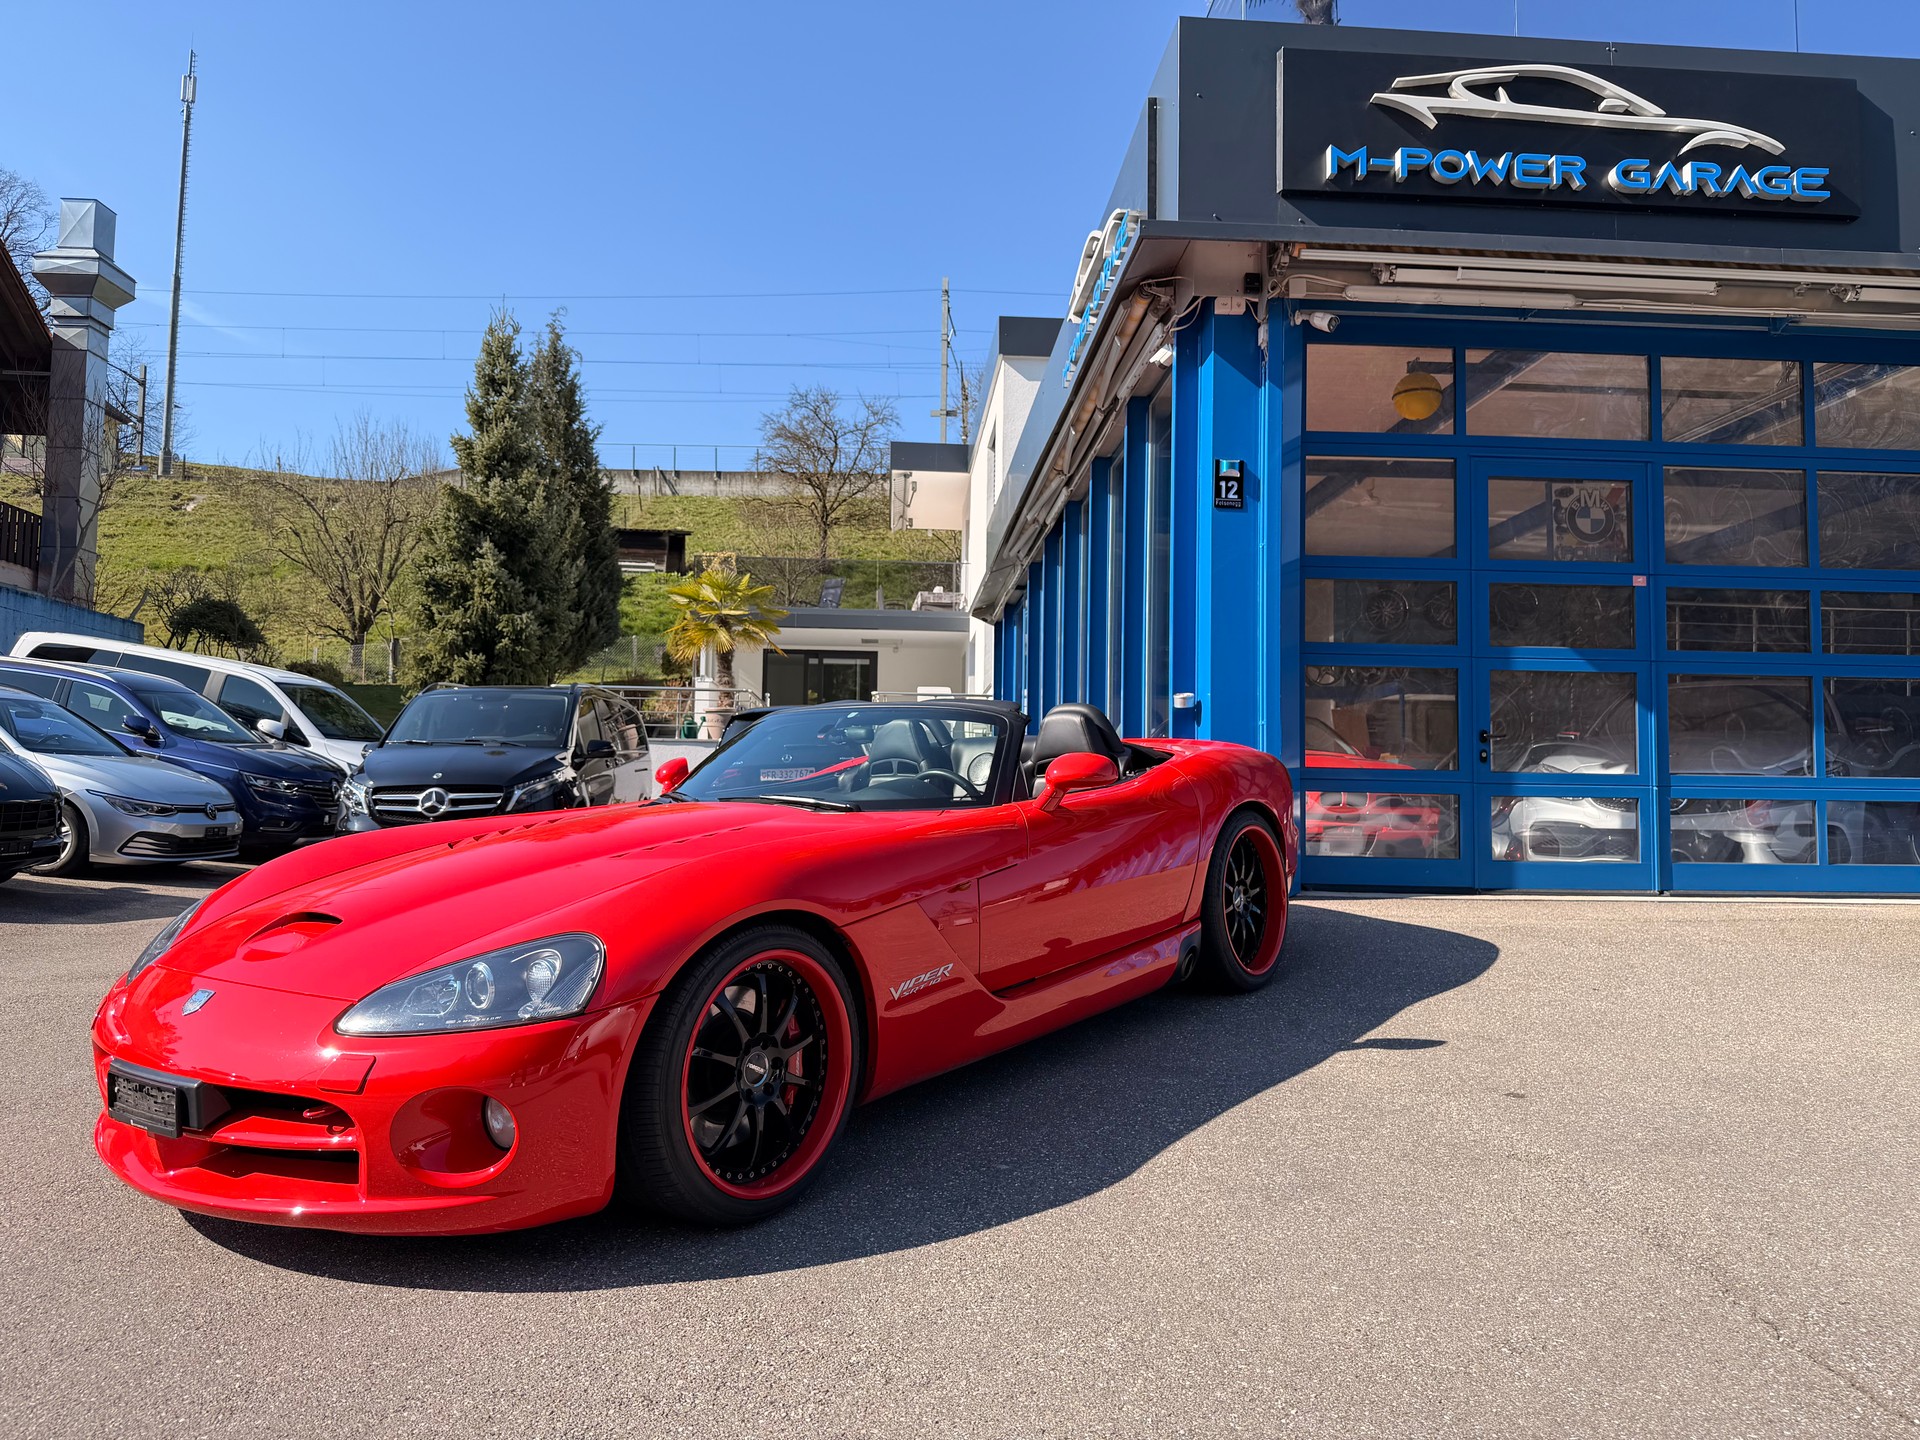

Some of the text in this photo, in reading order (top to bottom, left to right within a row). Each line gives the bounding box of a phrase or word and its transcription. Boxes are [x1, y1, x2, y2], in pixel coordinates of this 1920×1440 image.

[1326, 144, 1831, 202] M-POWER GARAGE
[1219, 480, 1239, 499] 12
[1572, 489, 1610, 512] BMW
[889, 962, 954, 1001] VIPER
